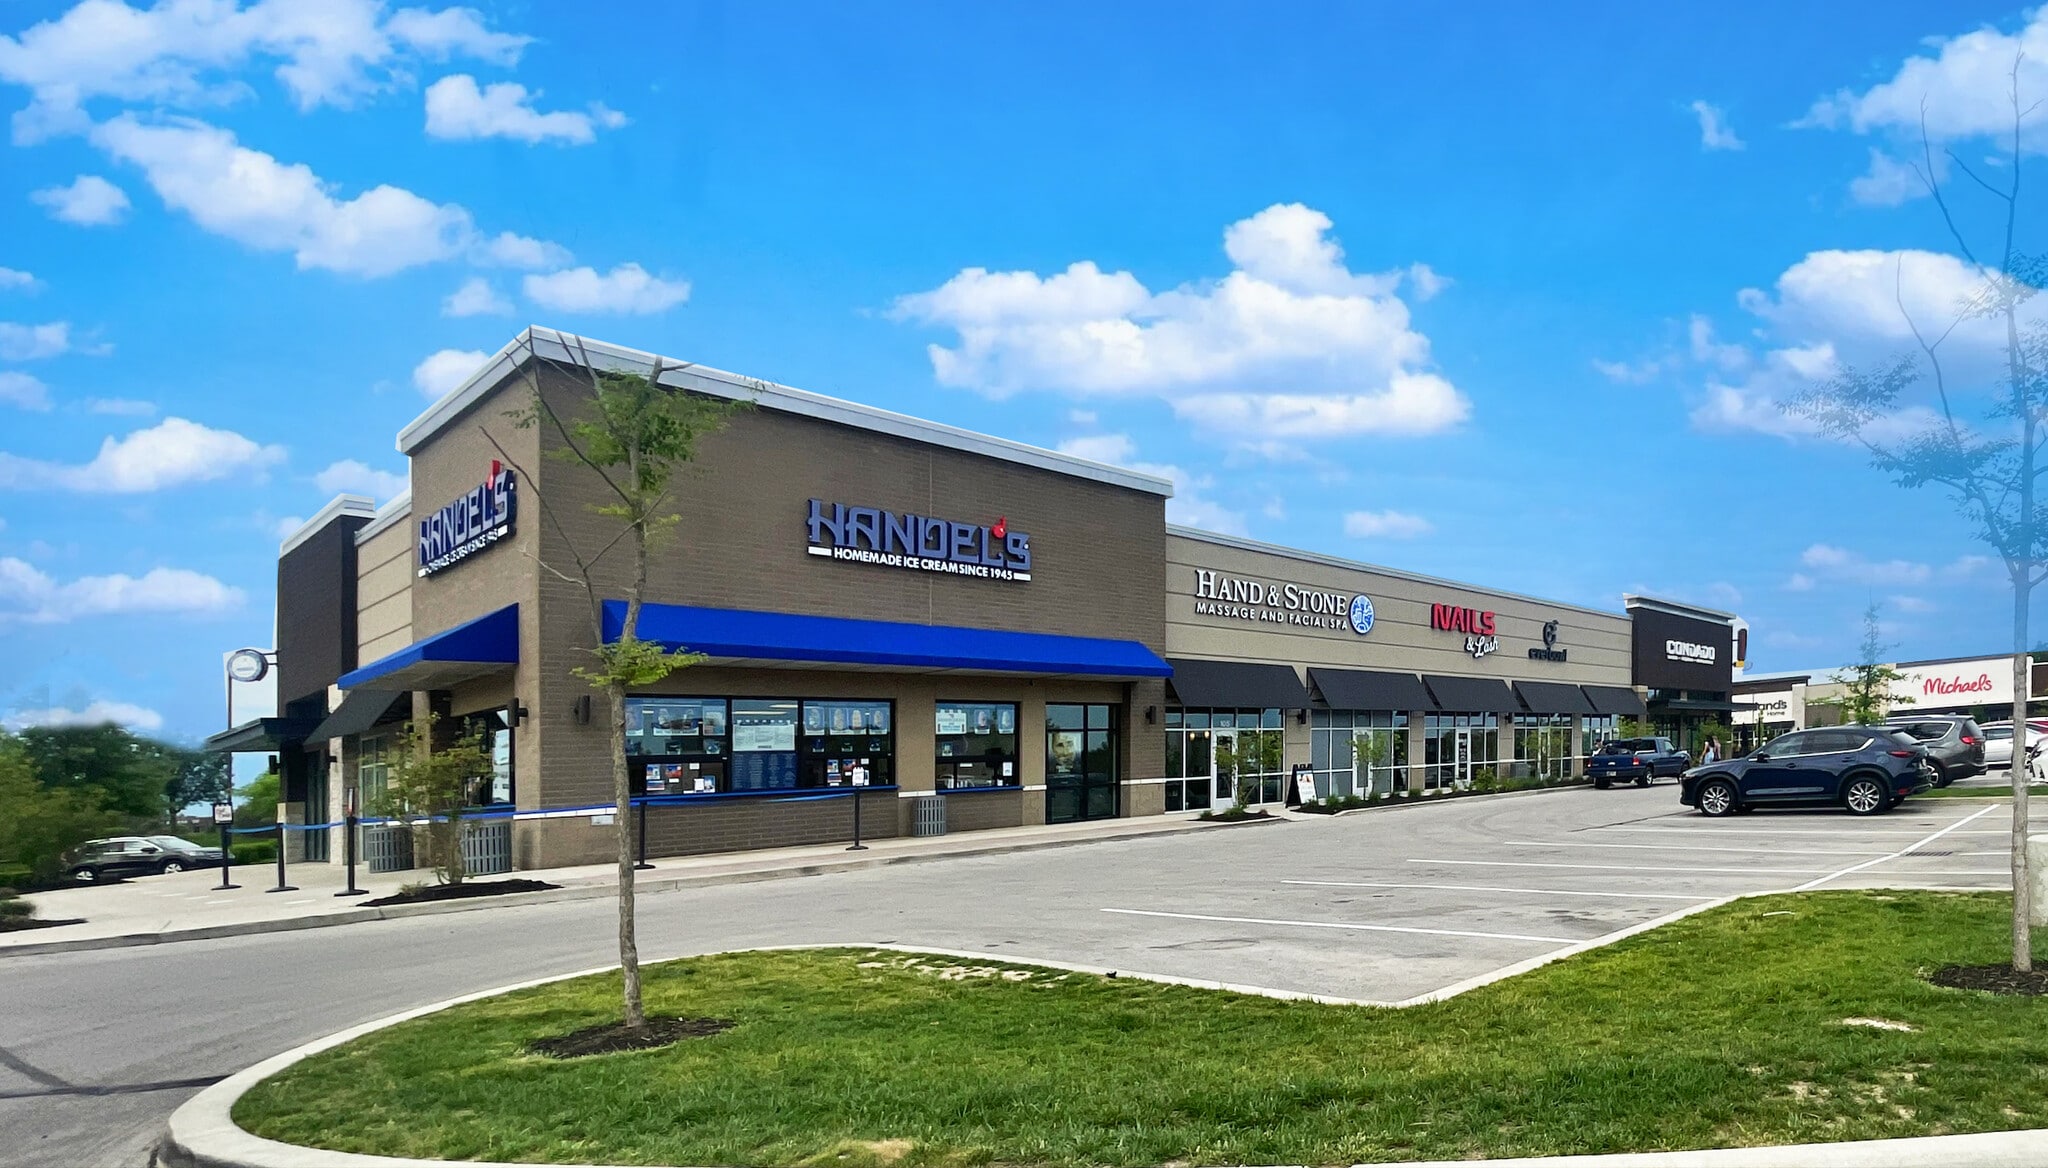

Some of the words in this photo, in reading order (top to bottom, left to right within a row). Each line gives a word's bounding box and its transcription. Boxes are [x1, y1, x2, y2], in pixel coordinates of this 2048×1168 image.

[807, 498, 1031, 570] HANDEL'S
[834, 547, 902, 567] HOMEMADE
[903, 555, 919, 568] ICE
[921, 558, 959, 574] CREAM
[959, 564, 988, 577] SINCE
[990, 567, 1013, 581] 1945
[1267, 585, 1280, 607] &
[1196, 602, 1255, 620] MASSAGE
[1260, 610, 1284, 622] AND
[1289, 613, 1325, 628] FACIAL
[1330, 619, 1348, 630] SPA
[1431, 603, 1496, 635] NAILS
[1666, 640, 1716, 660] CONDADO
[1923, 674, 1992, 695] Michaels
